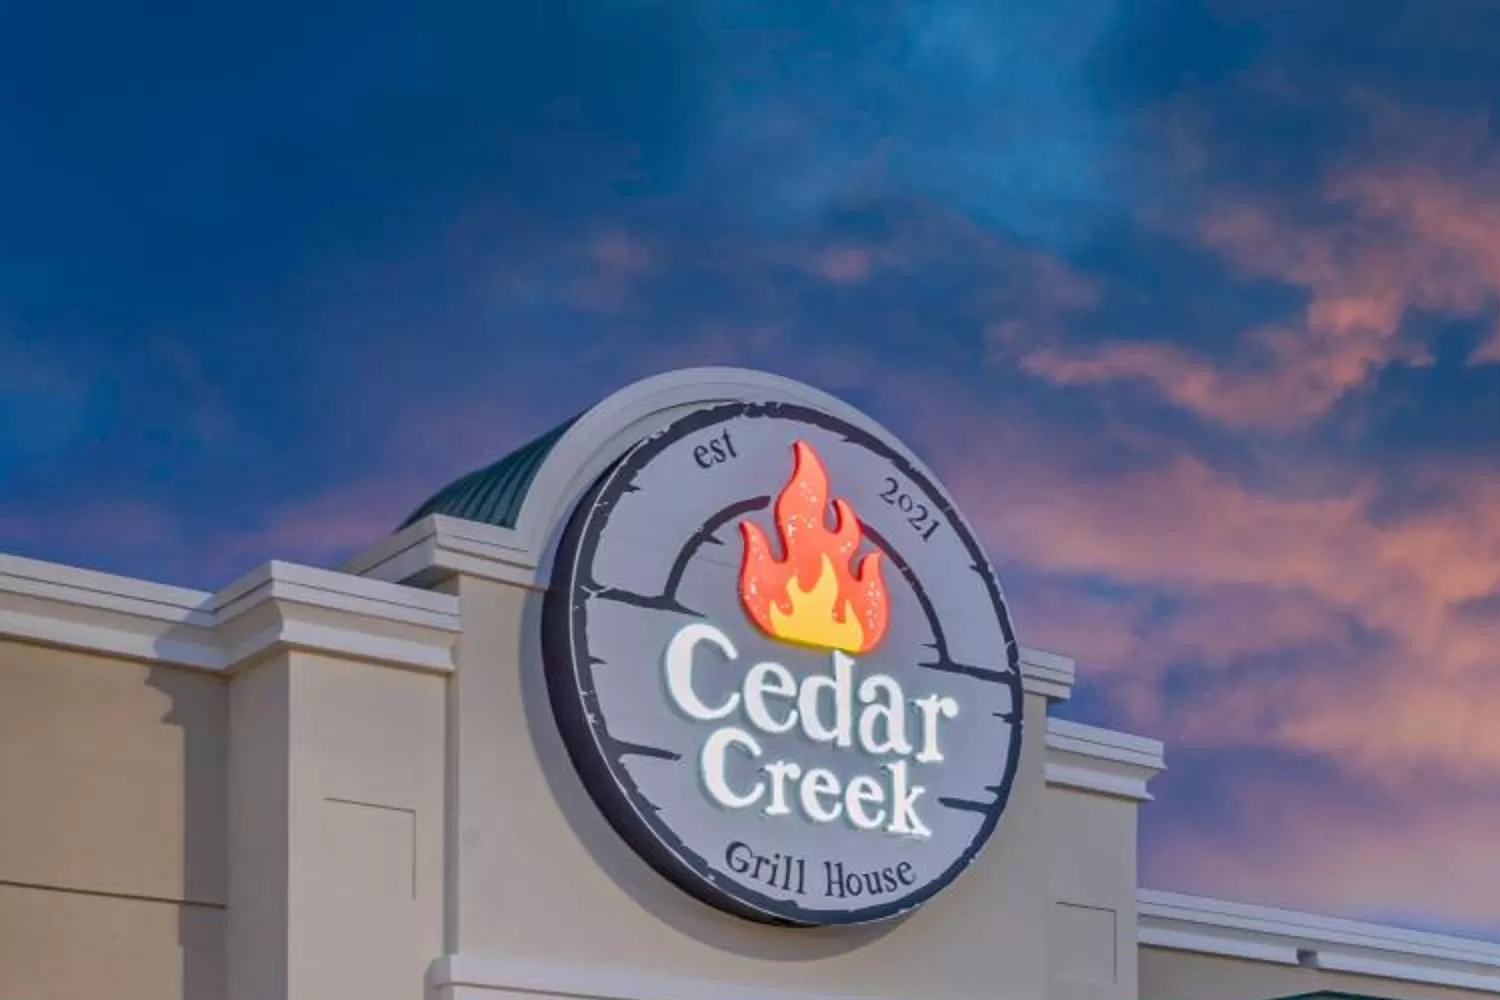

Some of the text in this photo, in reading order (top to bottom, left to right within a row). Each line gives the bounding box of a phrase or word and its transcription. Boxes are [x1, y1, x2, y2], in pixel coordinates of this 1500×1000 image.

[694, 428, 939, 542] est 2021
[666, 624, 958, 763] Cedar
[702, 727, 931, 837] Creek
[725, 841, 915, 898] Grill House
